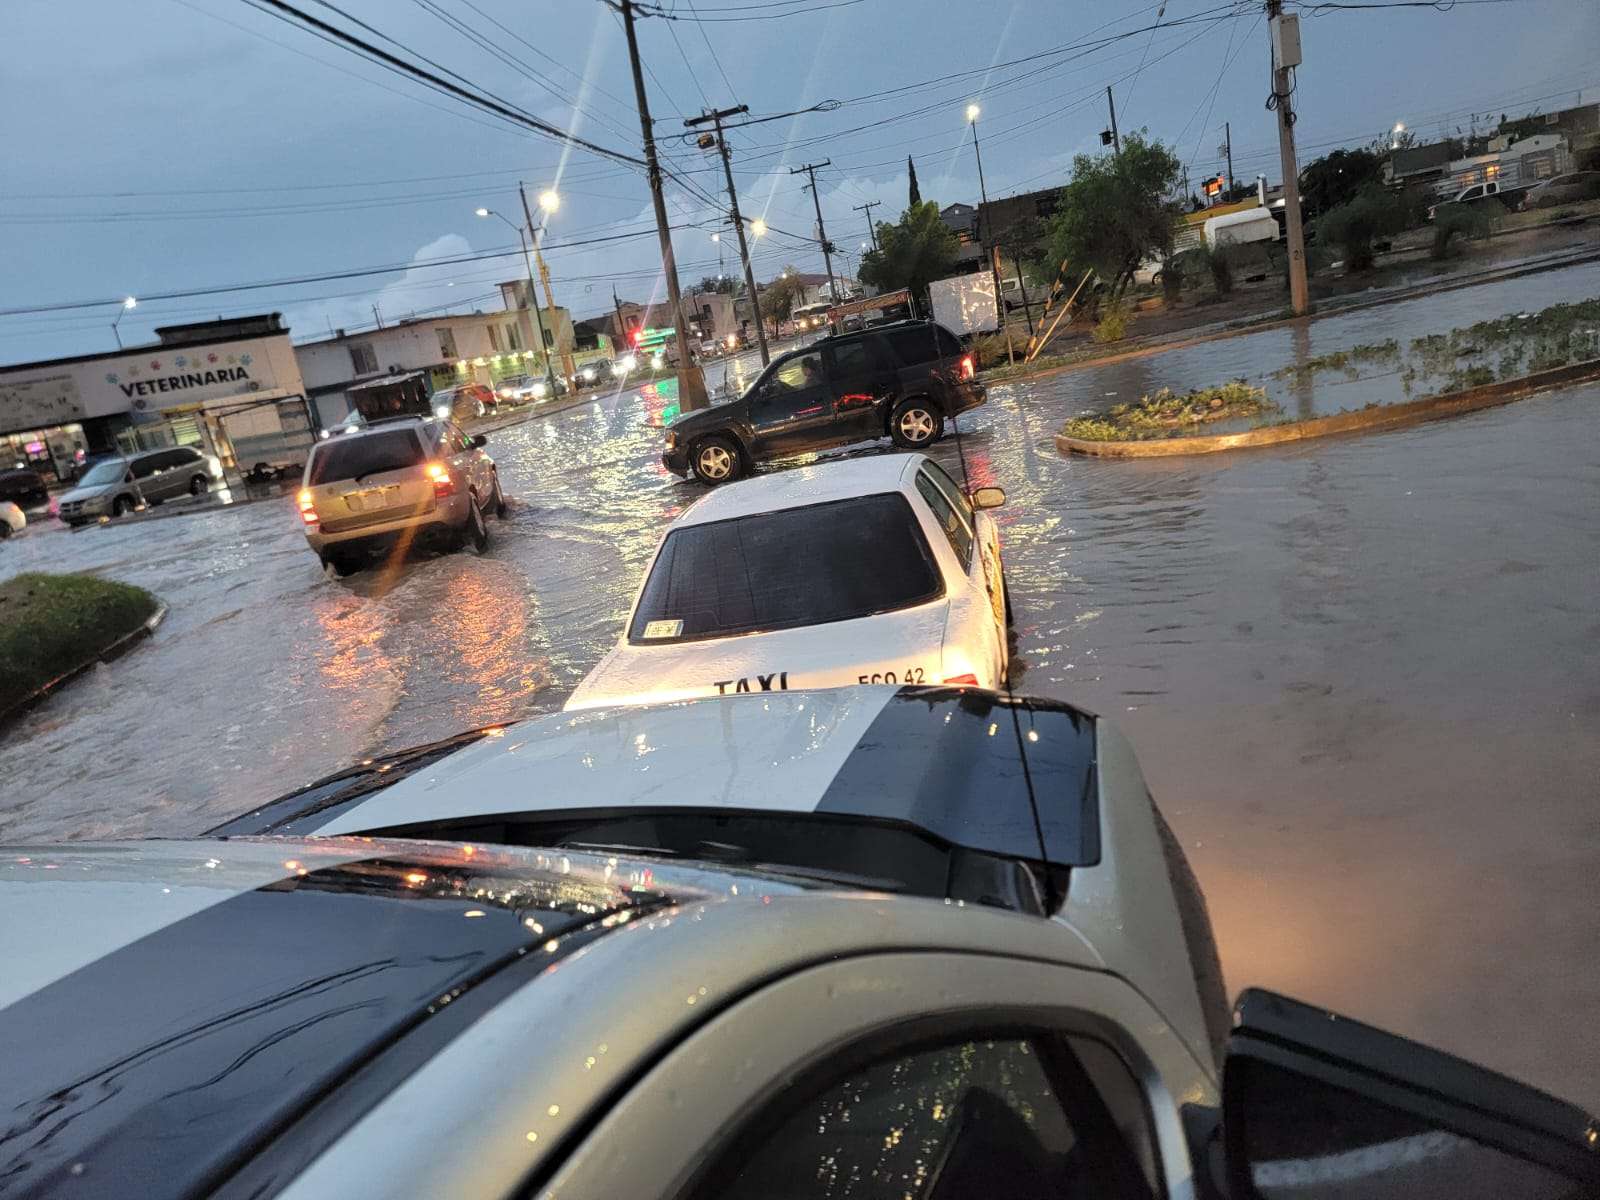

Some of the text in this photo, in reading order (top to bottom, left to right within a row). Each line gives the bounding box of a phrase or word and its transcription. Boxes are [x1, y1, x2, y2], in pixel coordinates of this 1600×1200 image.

[119, 366, 249, 397] VETERINARIA
[714, 671, 788, 695] TAXI
[904, 667, 925, 685] 42
